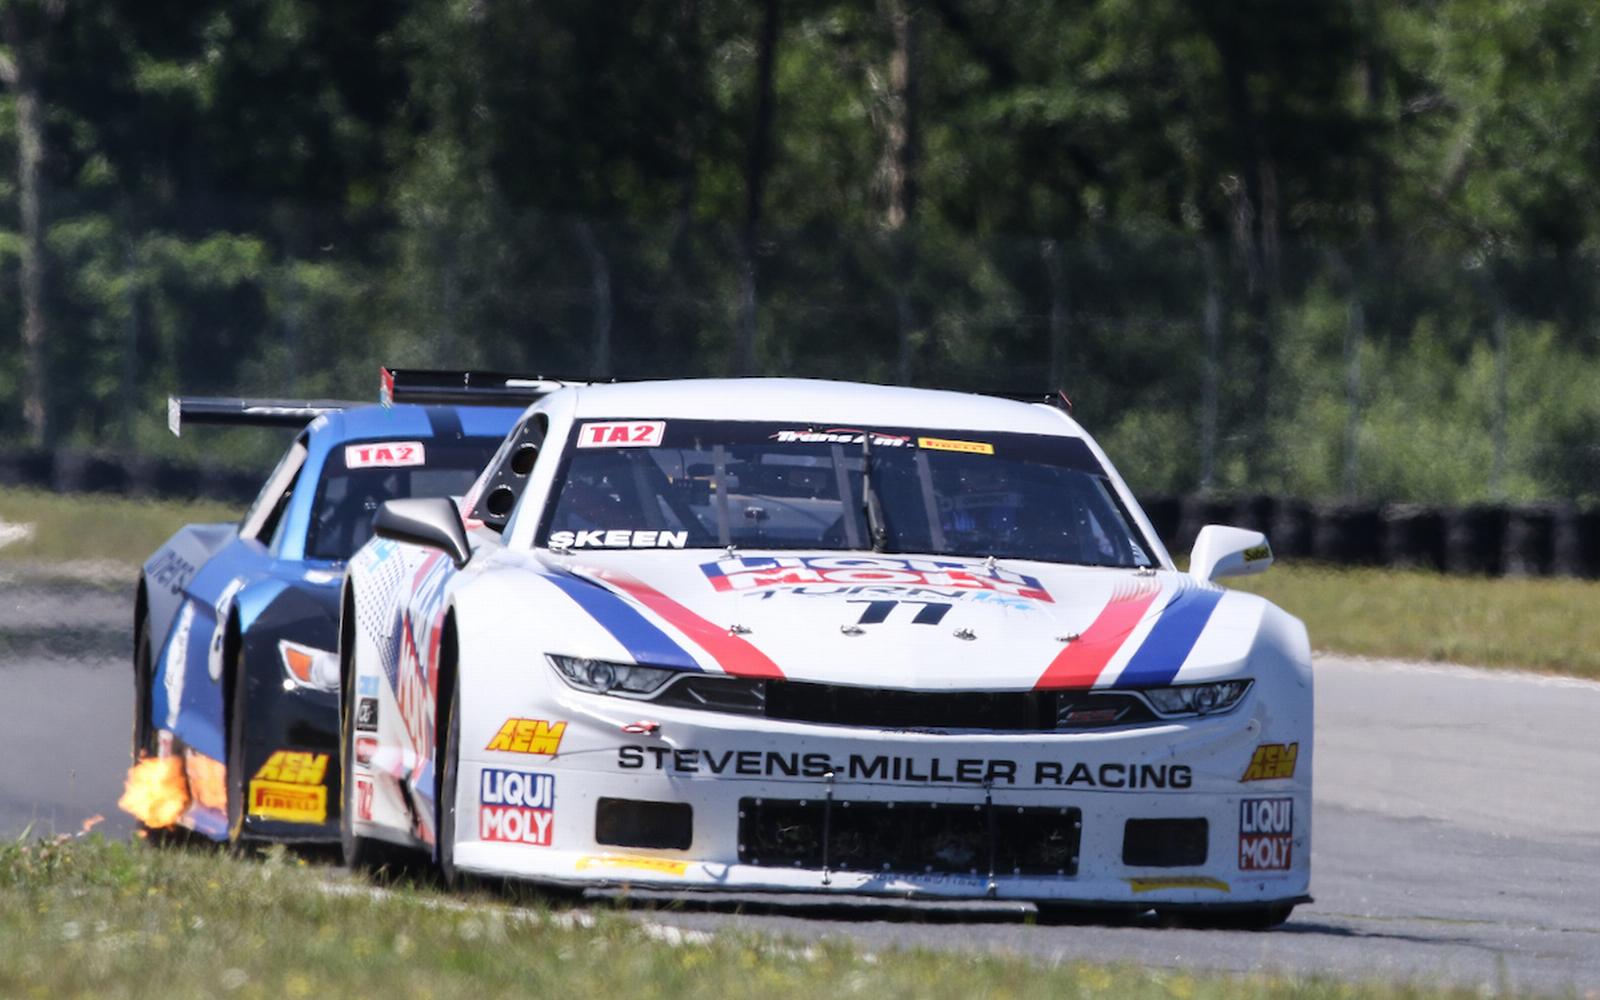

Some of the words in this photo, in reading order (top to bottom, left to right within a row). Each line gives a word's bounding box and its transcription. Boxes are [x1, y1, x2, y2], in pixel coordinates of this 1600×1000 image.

[589, 424, 655, 443] TA2
[358, 446, 415, 464] TA2
[547, 529, 689, 549] SKEEN
[483, 718, 569, 756] AEM
[251, 750, 331, 786] AEM
[617, 744, 1017, 786] STEVENS-MILLER
[1034, 760, 1193, 789] RACING
[1239, 742, 1299, 783] AEM
[255, 788, 319, 811] PIRELLI
[481, 770, 554, 807] LIQUI
[481, 808, 553, 843] MOLY
[1241, 800, 1291, 833] LIQUI
[1240, 837, 1291, 868] MOLY
